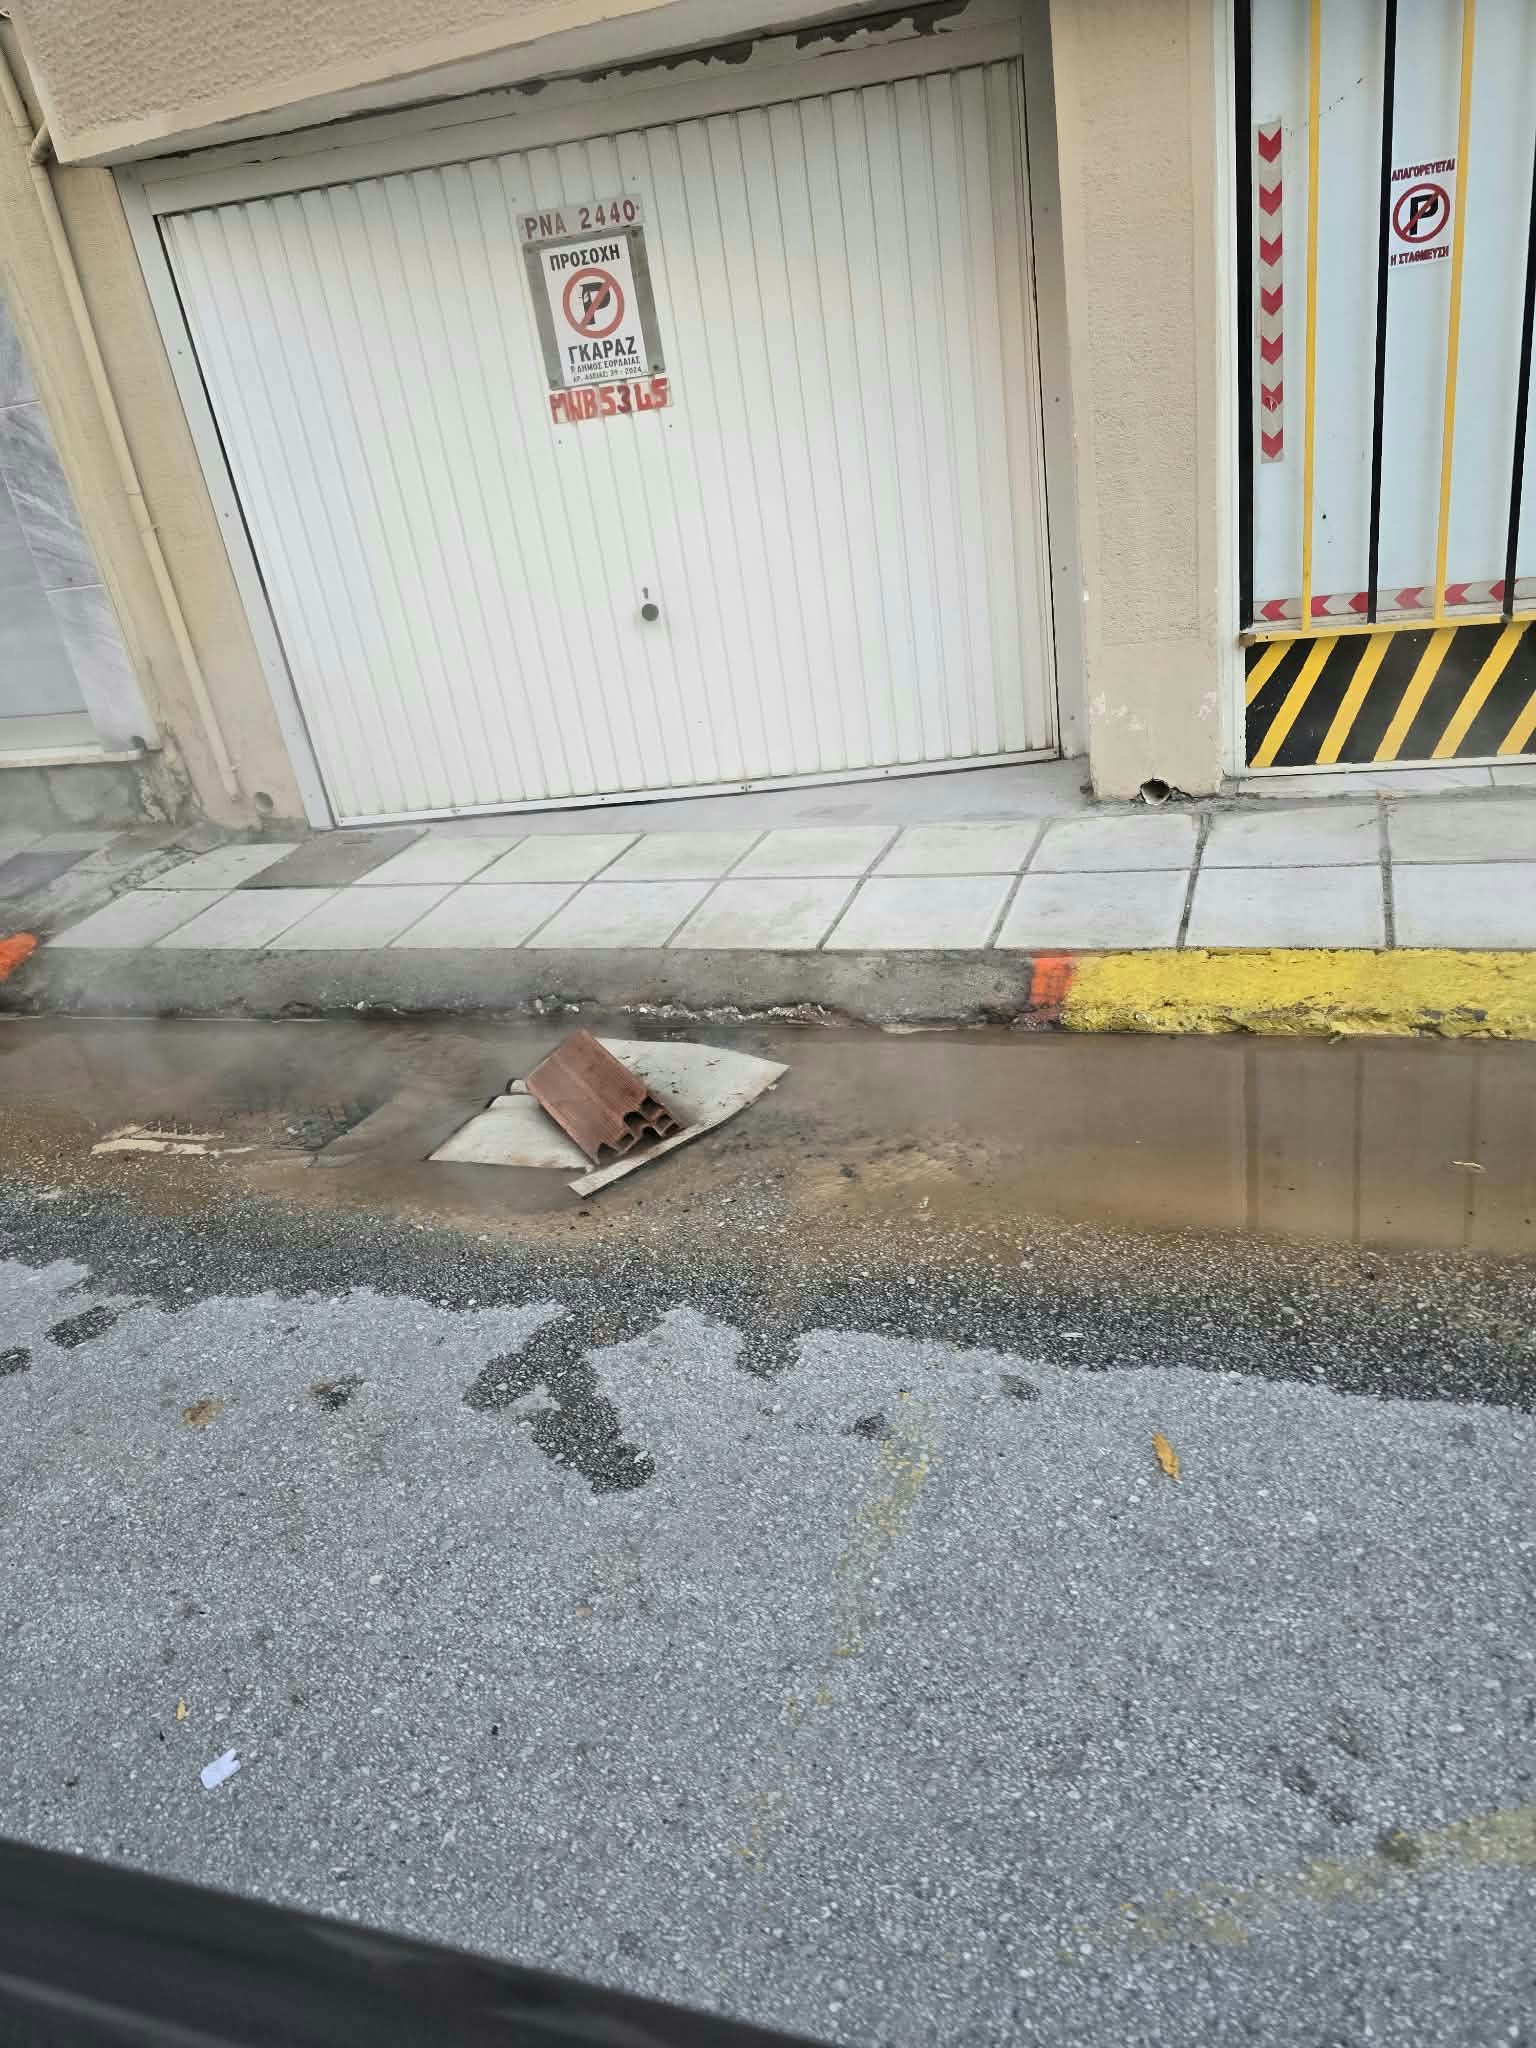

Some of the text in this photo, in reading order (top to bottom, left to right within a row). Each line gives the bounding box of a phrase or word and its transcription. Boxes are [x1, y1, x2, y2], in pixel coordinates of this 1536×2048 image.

[1391, 159, 1456, 182] ΑΠΑΓΟΡΕΥΕΤΑΙ
[578, 199, 636, 230] 2440
[549, 243, 620, 271] ΠΡΟΣΟΧΗ
[1399, 246, 1450, 265] ΣΤΑΘΜΕΥΣΗ
[567, 336, 637, 365] ΓΚΑΡΑΖ
[577, 355, 641, 373] ΔΗΜΟΣ ΕΟΡΔΑΙΑΣ
